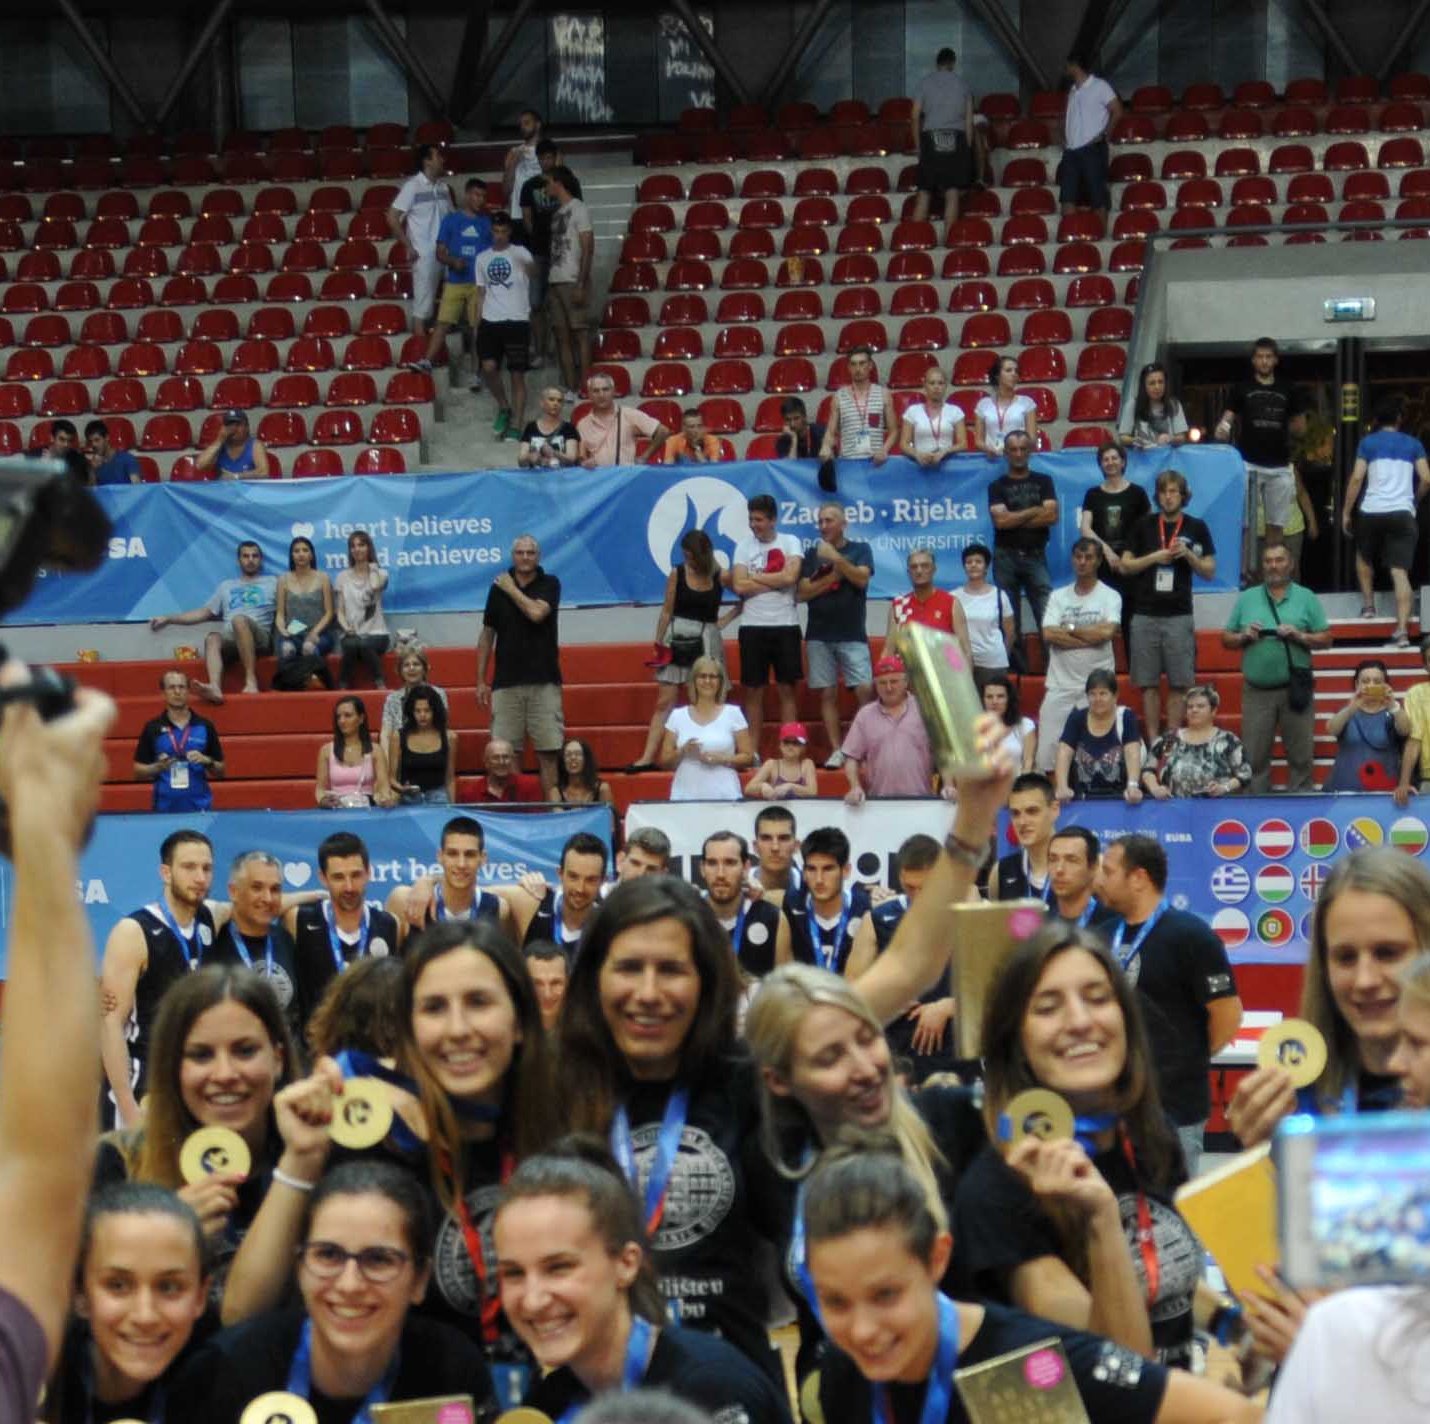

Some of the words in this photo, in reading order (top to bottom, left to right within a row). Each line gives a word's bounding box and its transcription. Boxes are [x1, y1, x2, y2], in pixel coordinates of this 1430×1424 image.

[892, 498, 977, 527] Rijeka
[395, 515, 492, 537] believes
[878, 533, 986, 550] UNIVERSITIES
[396, 545, 502, 565] achieves
